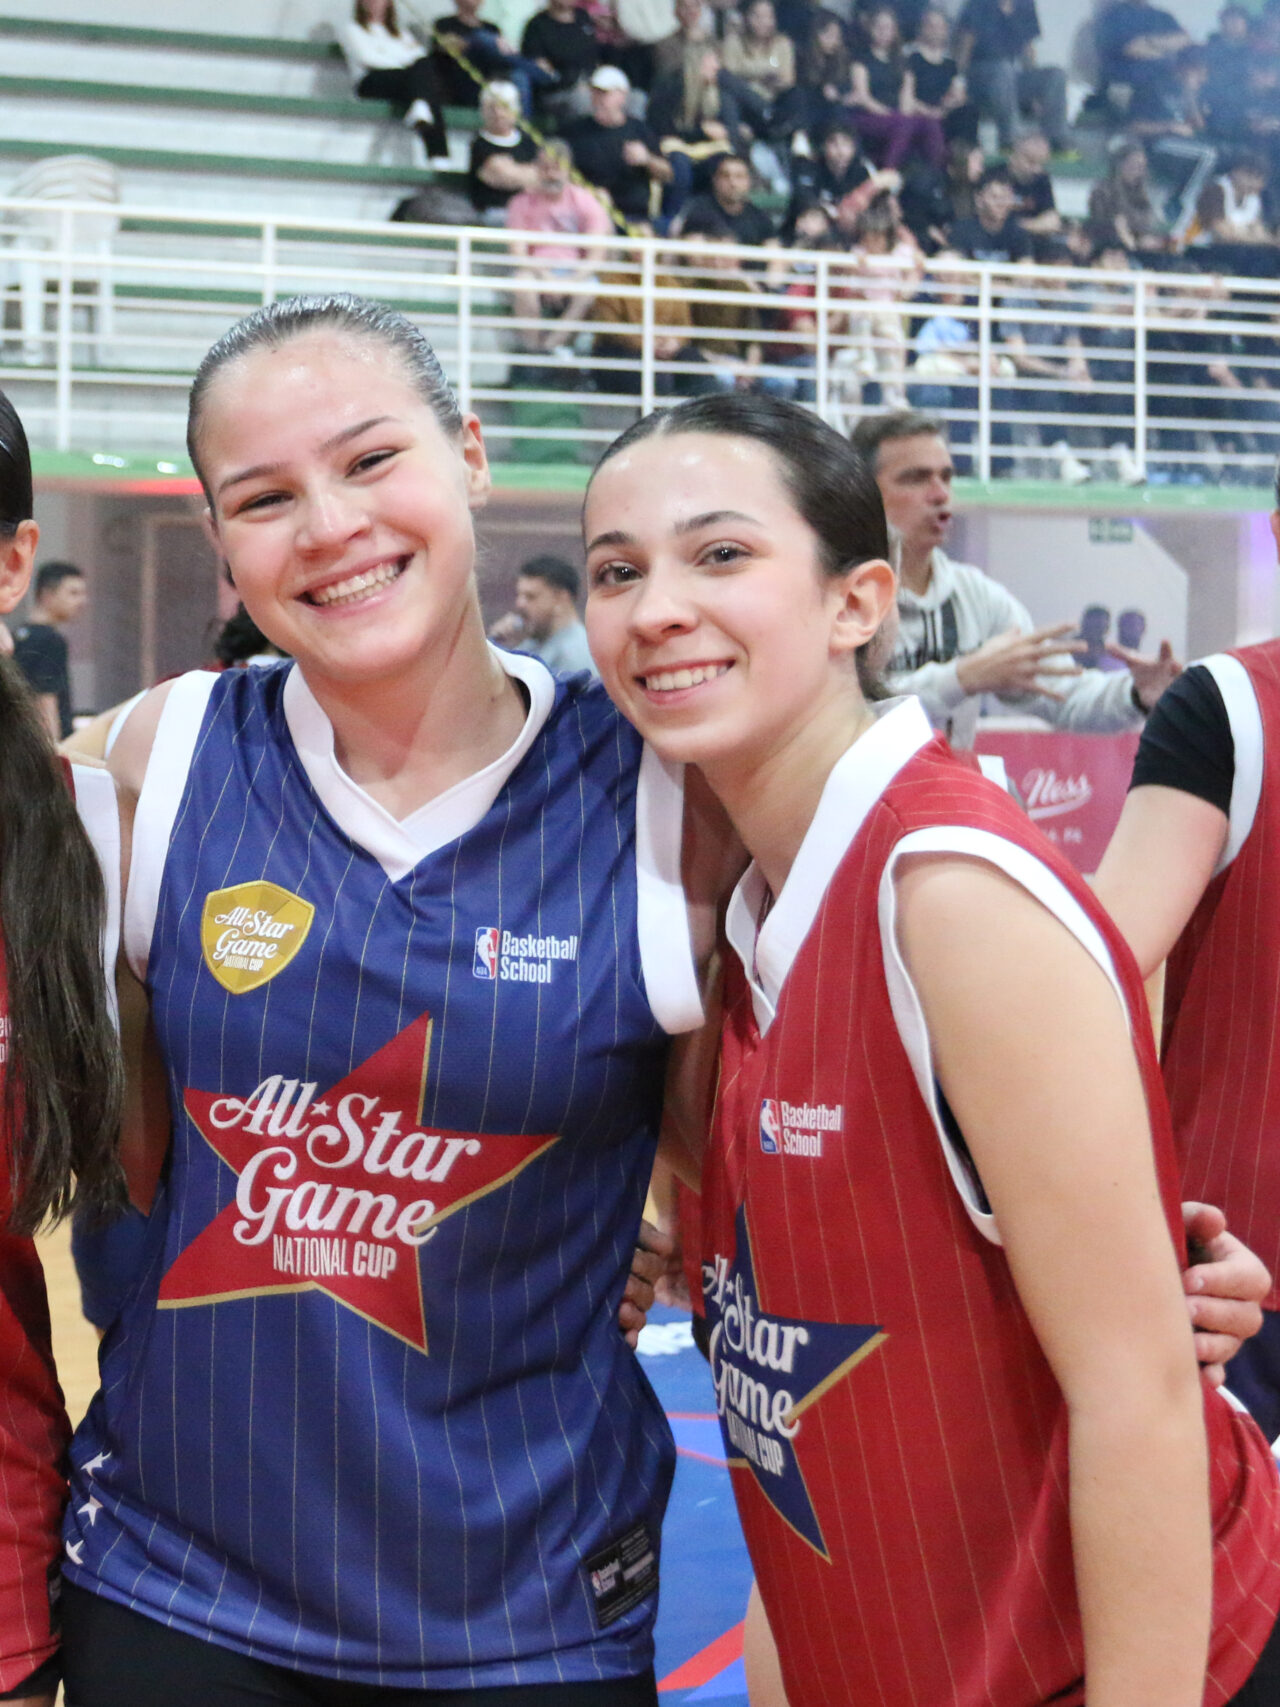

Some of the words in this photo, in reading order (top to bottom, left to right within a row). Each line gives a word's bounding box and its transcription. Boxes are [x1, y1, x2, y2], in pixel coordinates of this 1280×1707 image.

[212, 928, 277, 960] Game
[501, 930, 578, 960] Basketball
[500, 956, 551, 983] School
[781, 1101, 842, 1131] Basketball
[783, 1128, 823, 1157] School
[232, 1146, 439, 1246] Game
[272, 1233, 348, 1276] NATIONAL
[352, 1240, 397, 1279] CUP
[759, 1432, 785, 1478] CUP
